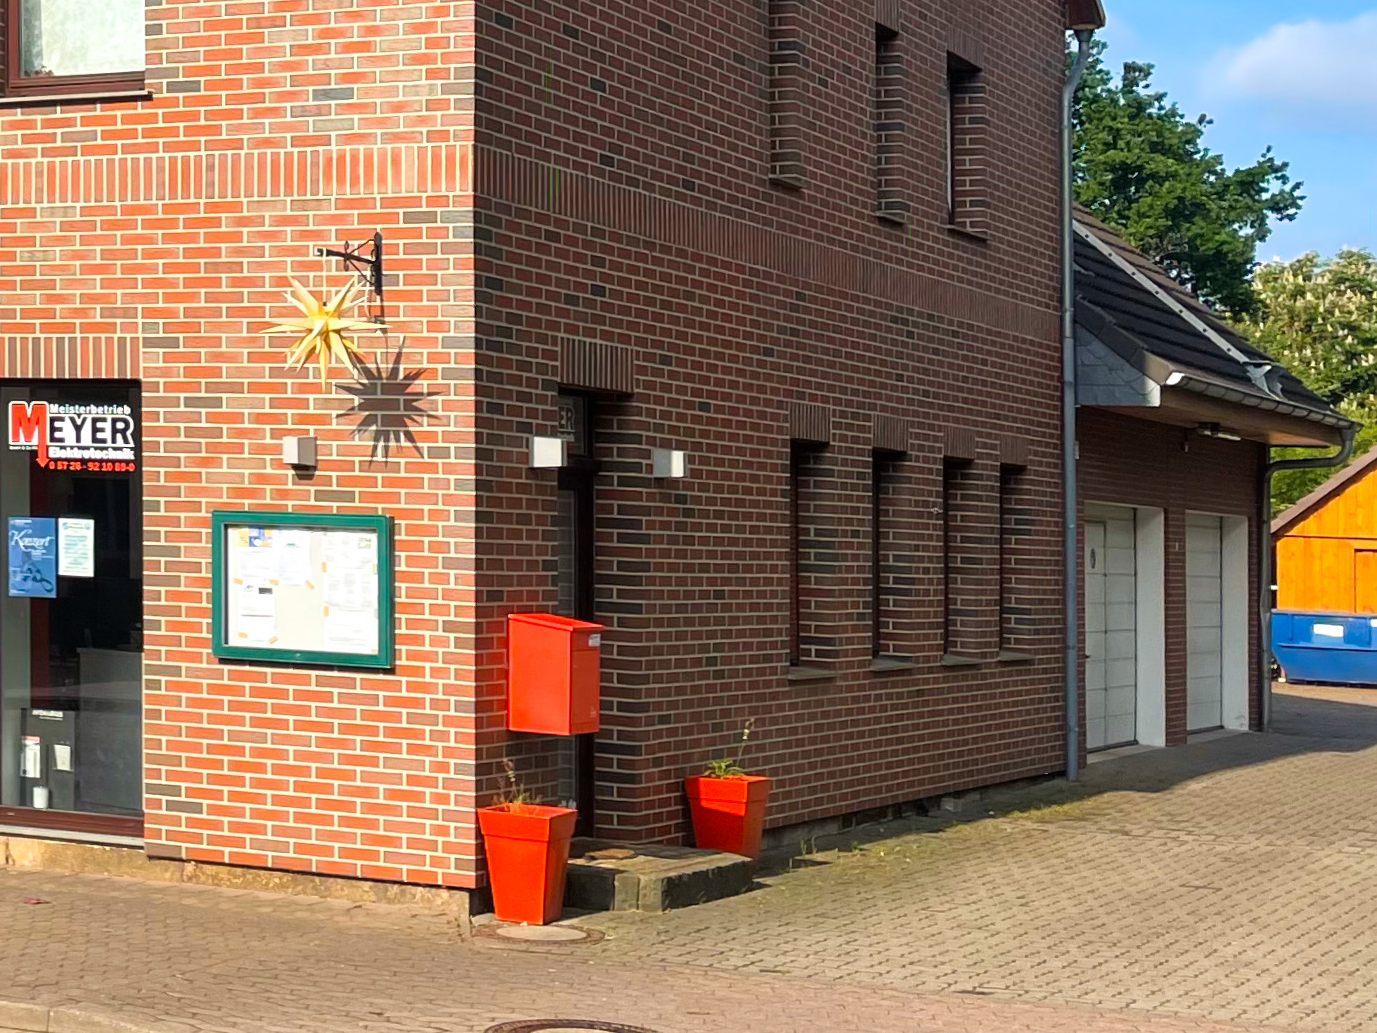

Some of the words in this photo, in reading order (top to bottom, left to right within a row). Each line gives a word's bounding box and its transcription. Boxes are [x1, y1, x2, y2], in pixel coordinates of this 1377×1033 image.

[49, 404, 131, 415] Meisterbetrieb
[10, 402, 134, 447] MEYER
[48, 447, 135, 460] Elektrotechnik
